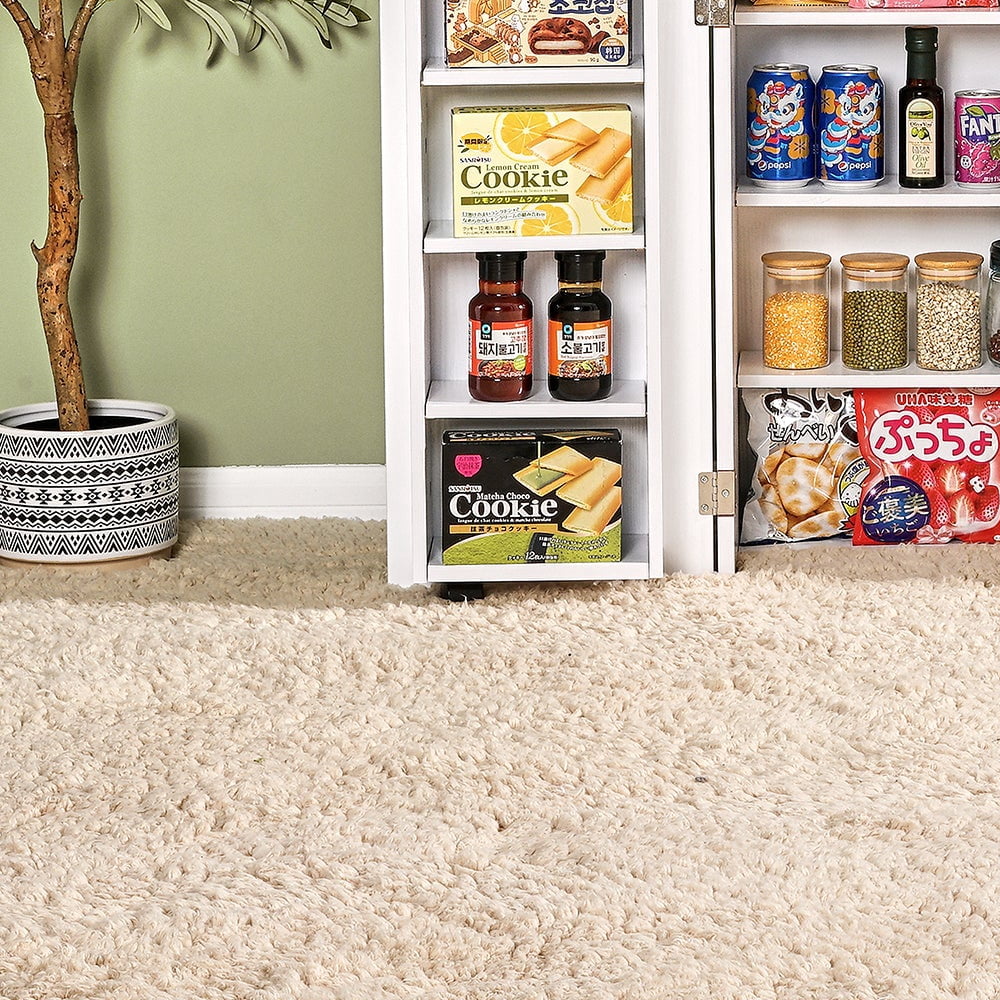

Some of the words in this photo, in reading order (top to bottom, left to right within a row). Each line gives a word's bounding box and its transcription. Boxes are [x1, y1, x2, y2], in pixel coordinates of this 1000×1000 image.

[767, 161, 792, 170] pepsi
[848, 161, 872, 170] pepsi
[460, 164, 569, 190] Cookie
[474, 195, 557, 205] レモンクリームクッキー
[478, 341, 523, 356] 돼지불고기
[560, 341, 601, 355] 소불고기
[896, 392, 973, 406] UHA味覚糖
[767, 422, 836, 442] せんべい
[874, 416, 994, 457] ぷっちょ
[476, 492, 505, 500] Matcha
[506, 492, 531, 500] Choco
[449, 493, 559, 519] Cookie
[862, 492, 930, 526] ご褒美
[875, 518, 919, 537] いちご
